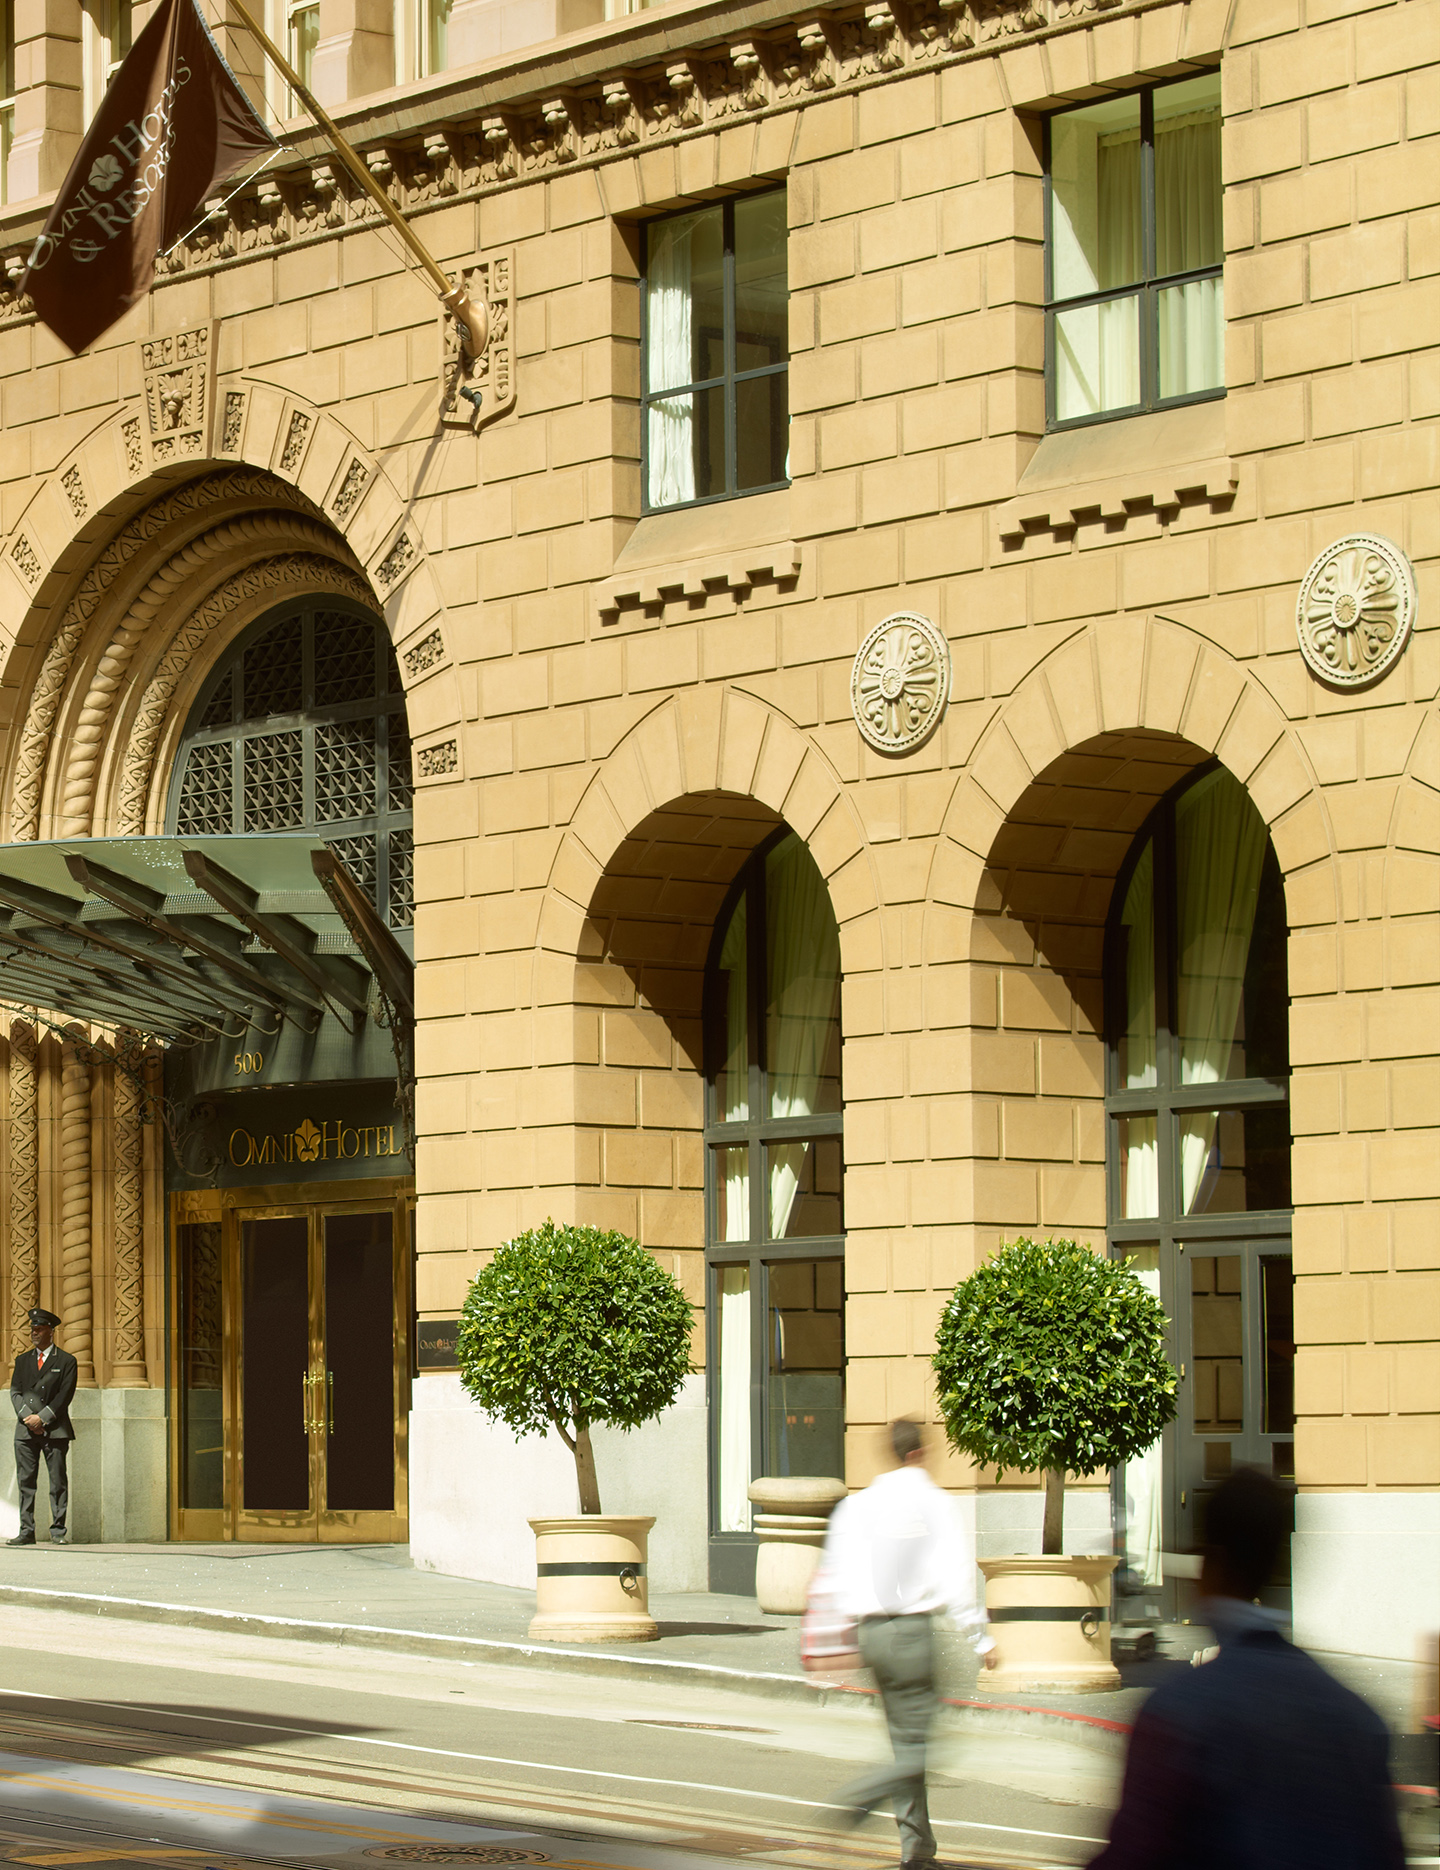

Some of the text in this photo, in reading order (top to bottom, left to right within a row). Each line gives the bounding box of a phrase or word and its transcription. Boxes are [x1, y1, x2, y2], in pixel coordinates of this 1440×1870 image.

[27, 185, 96, 270] OMNI
[69, 238, 107, 263] &
[234, 1052, 263, 1076] 500
[229, 1120, 403, 1167] OMNI HOTEL
